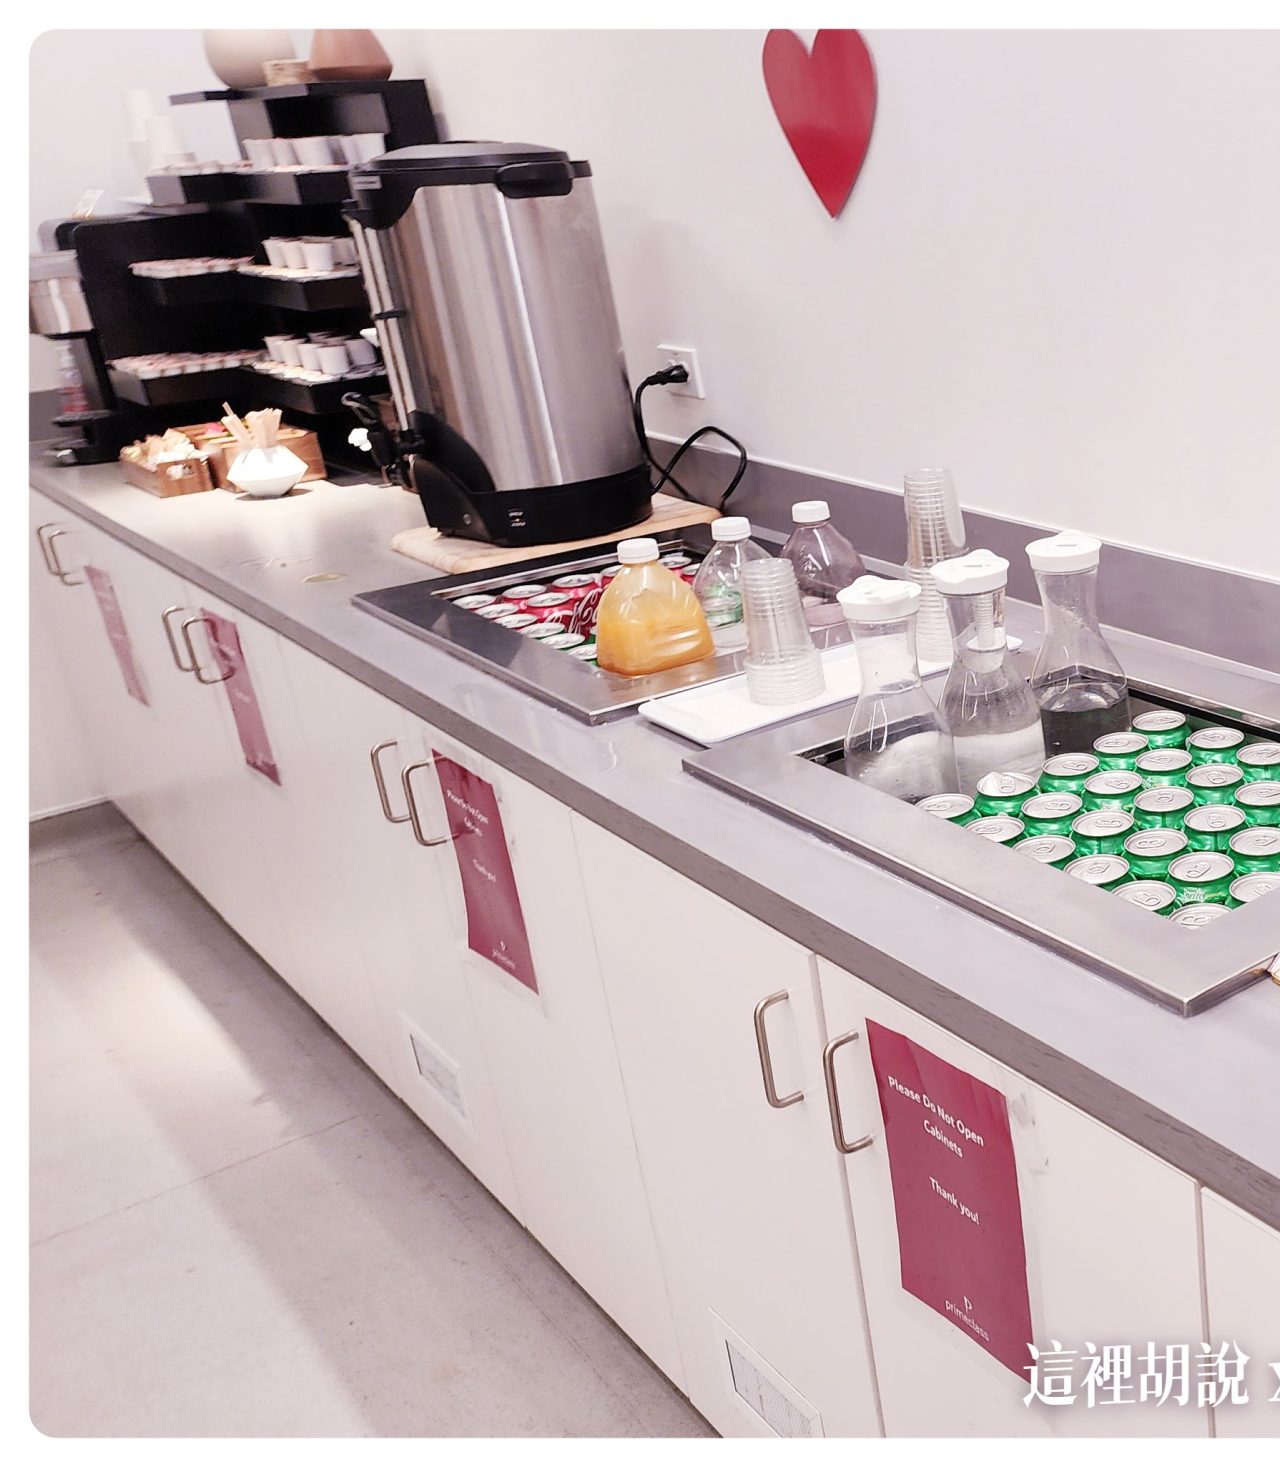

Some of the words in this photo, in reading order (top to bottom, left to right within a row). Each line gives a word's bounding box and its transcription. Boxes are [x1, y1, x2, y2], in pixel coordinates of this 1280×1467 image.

[888, 1075, 921, 1104] Please
[922, 1093, 937, 1114] Do
[937, 1104, 956, 1129] Not
[956, 1120, 985, 1148] Open
[923, 1119, 964, 1159] Cabinets
[928, 1175, 959, 1209] Thank
[959, 1201, 980, 1226] you!
[944, 1299, 991, 1342] primeclass
